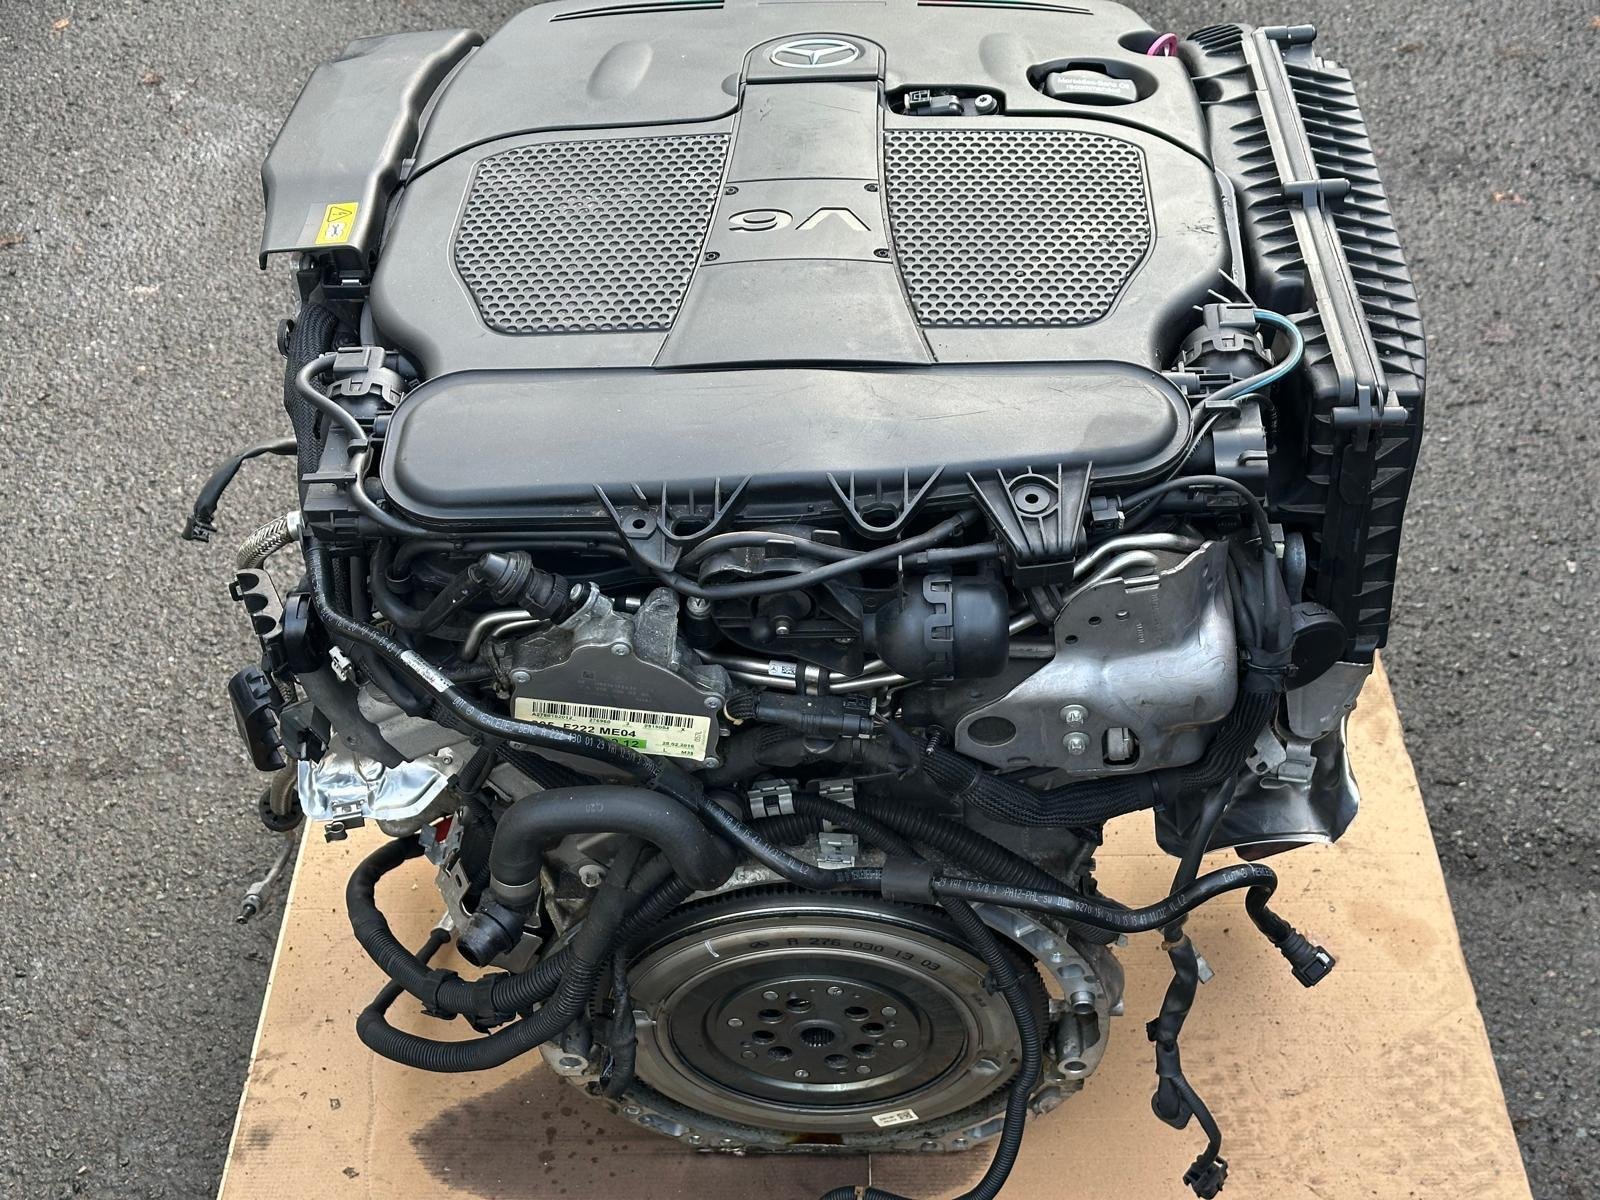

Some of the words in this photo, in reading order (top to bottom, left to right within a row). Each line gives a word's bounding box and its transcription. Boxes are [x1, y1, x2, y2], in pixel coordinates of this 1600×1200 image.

[729, 207, 871, 232] V6
[600, 727, 637, 738] ME04
[787, 938, 798, 946] A
[809, 938, 841, 946] 276
[853, 940, 884, 953] 030
[894, 950, 914, 960] 13
[920, 958, 941, 972] 03
